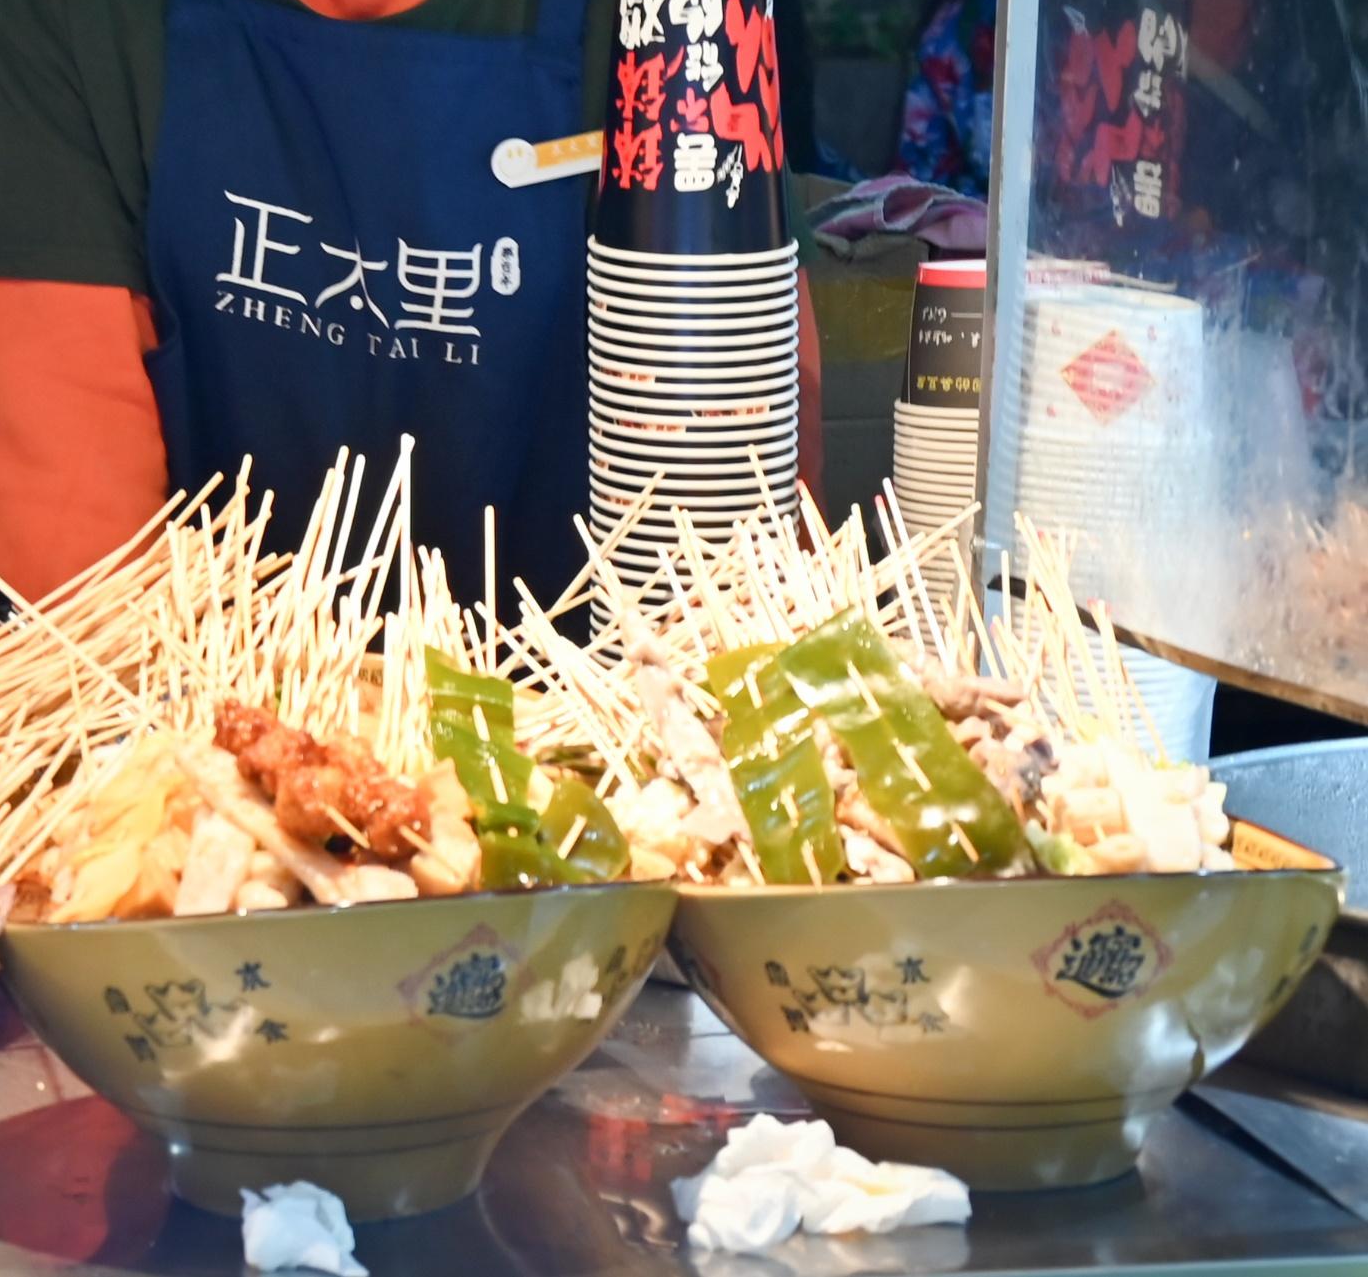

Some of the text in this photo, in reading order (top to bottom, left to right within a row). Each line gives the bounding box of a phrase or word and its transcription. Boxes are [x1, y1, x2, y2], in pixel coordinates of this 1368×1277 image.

[214, 290, 481, 366] ZHENG TAI LI
